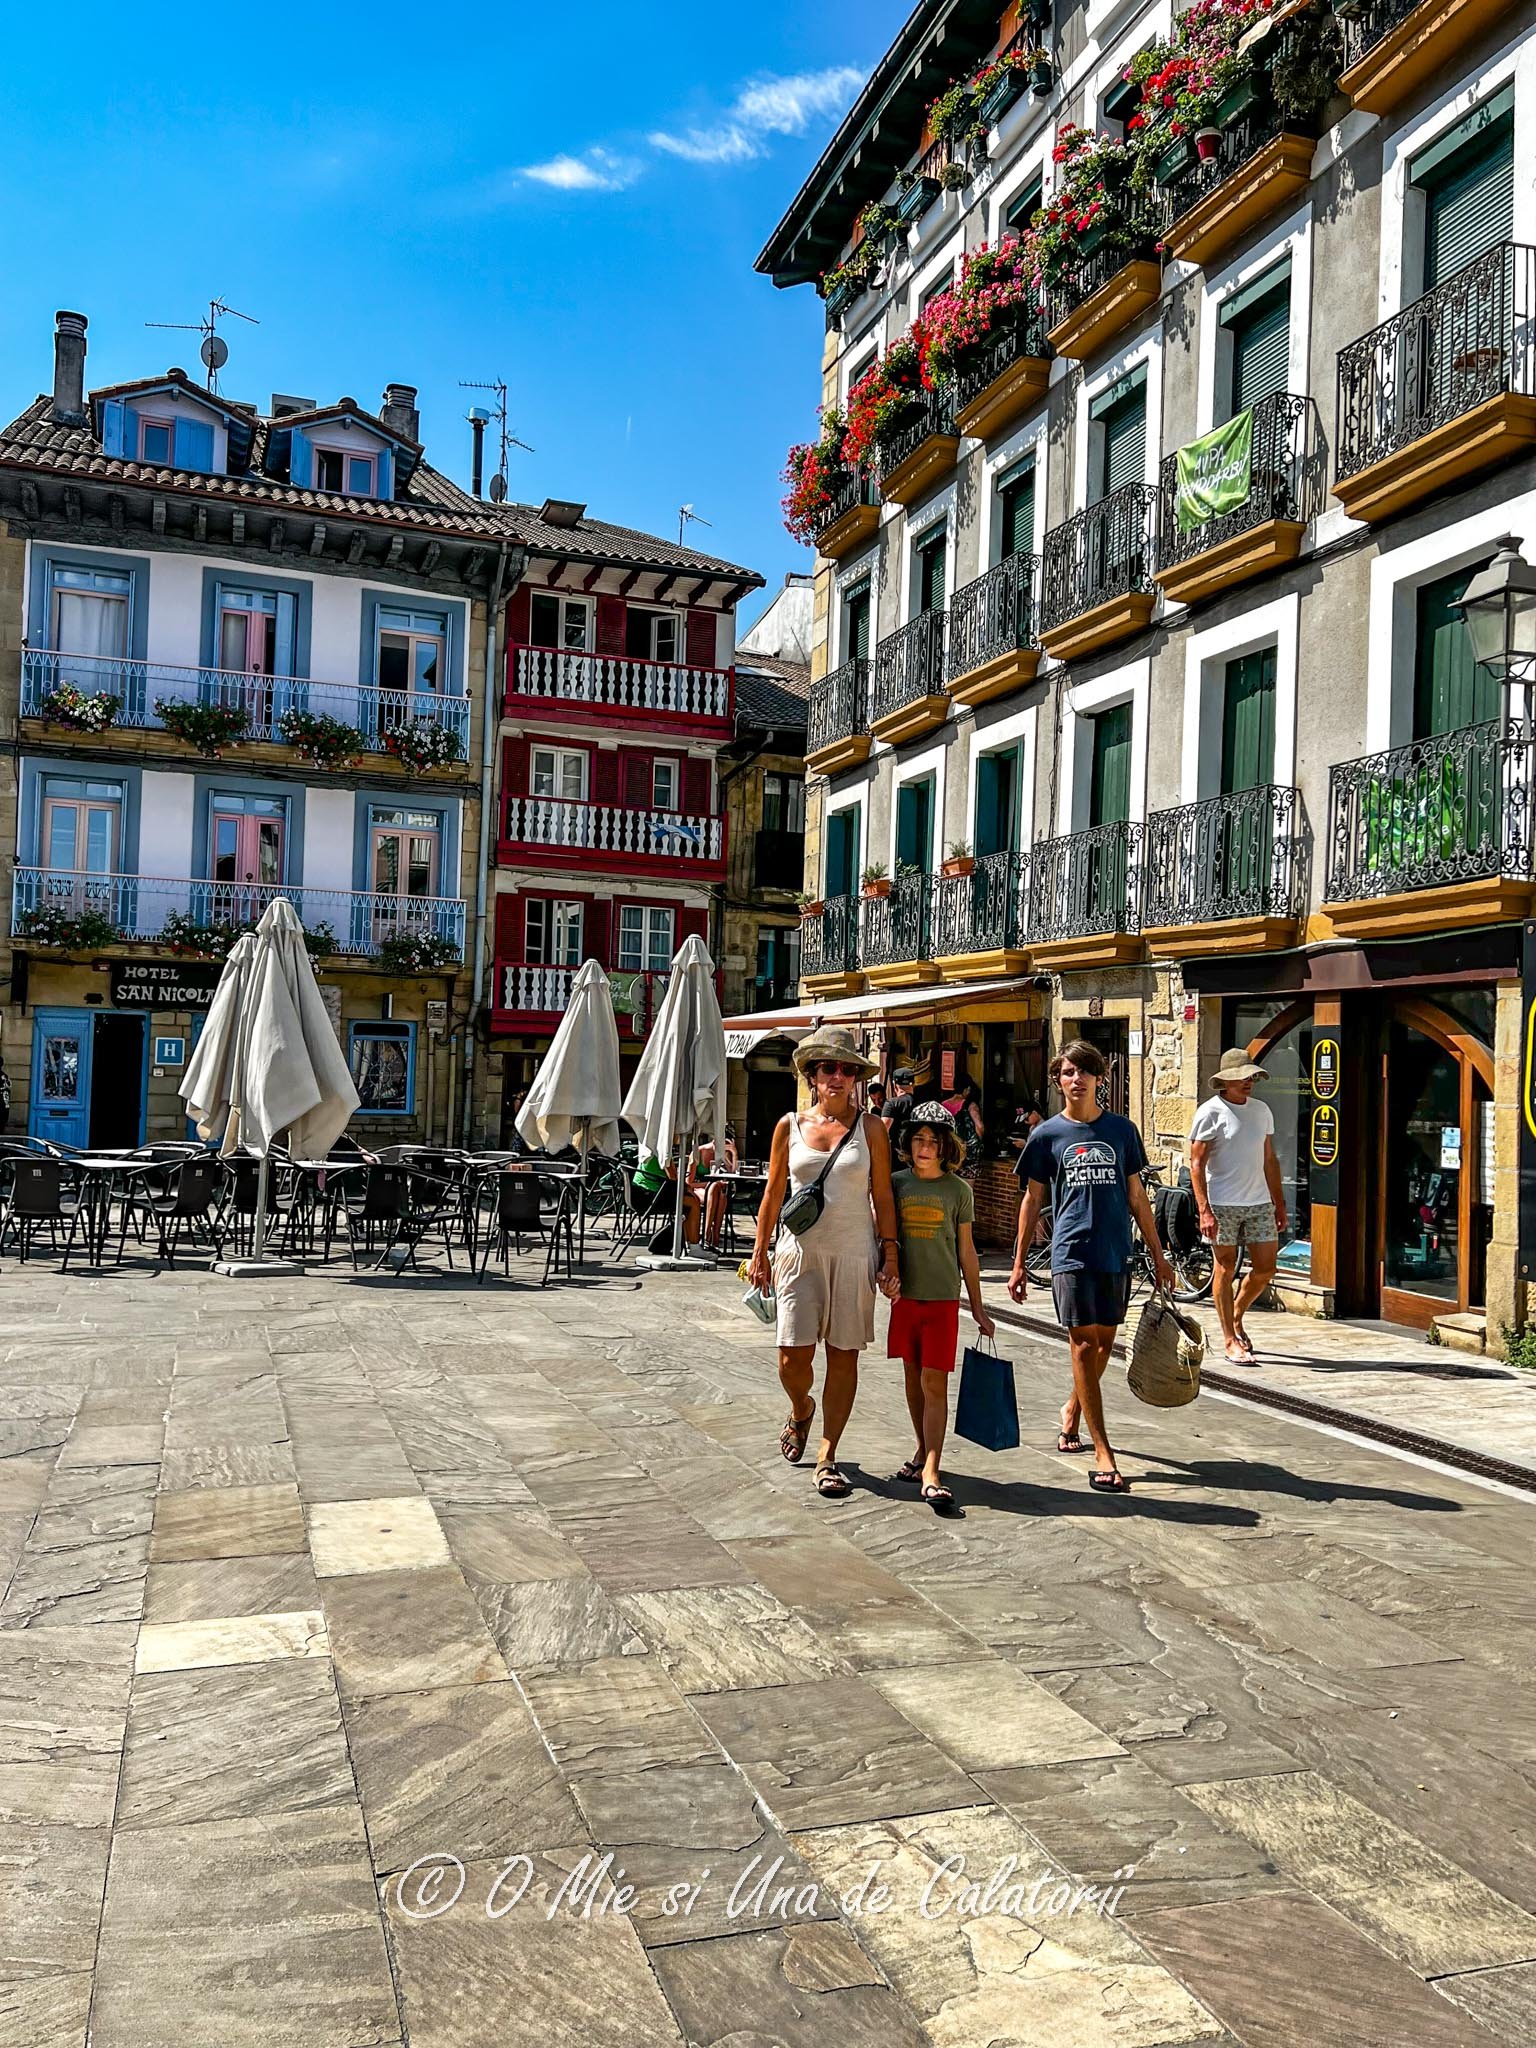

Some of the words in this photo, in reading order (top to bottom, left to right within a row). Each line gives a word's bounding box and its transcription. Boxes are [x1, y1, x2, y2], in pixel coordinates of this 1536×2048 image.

[124, 966, 180, 980] HOTEL
[116, 985, 154, 1001] SAN
[158, 986, 216, 1003] NiCOLA
[164, 1043, 176, 1056] H
[1066, 1167, 1115, 1181] Picture
